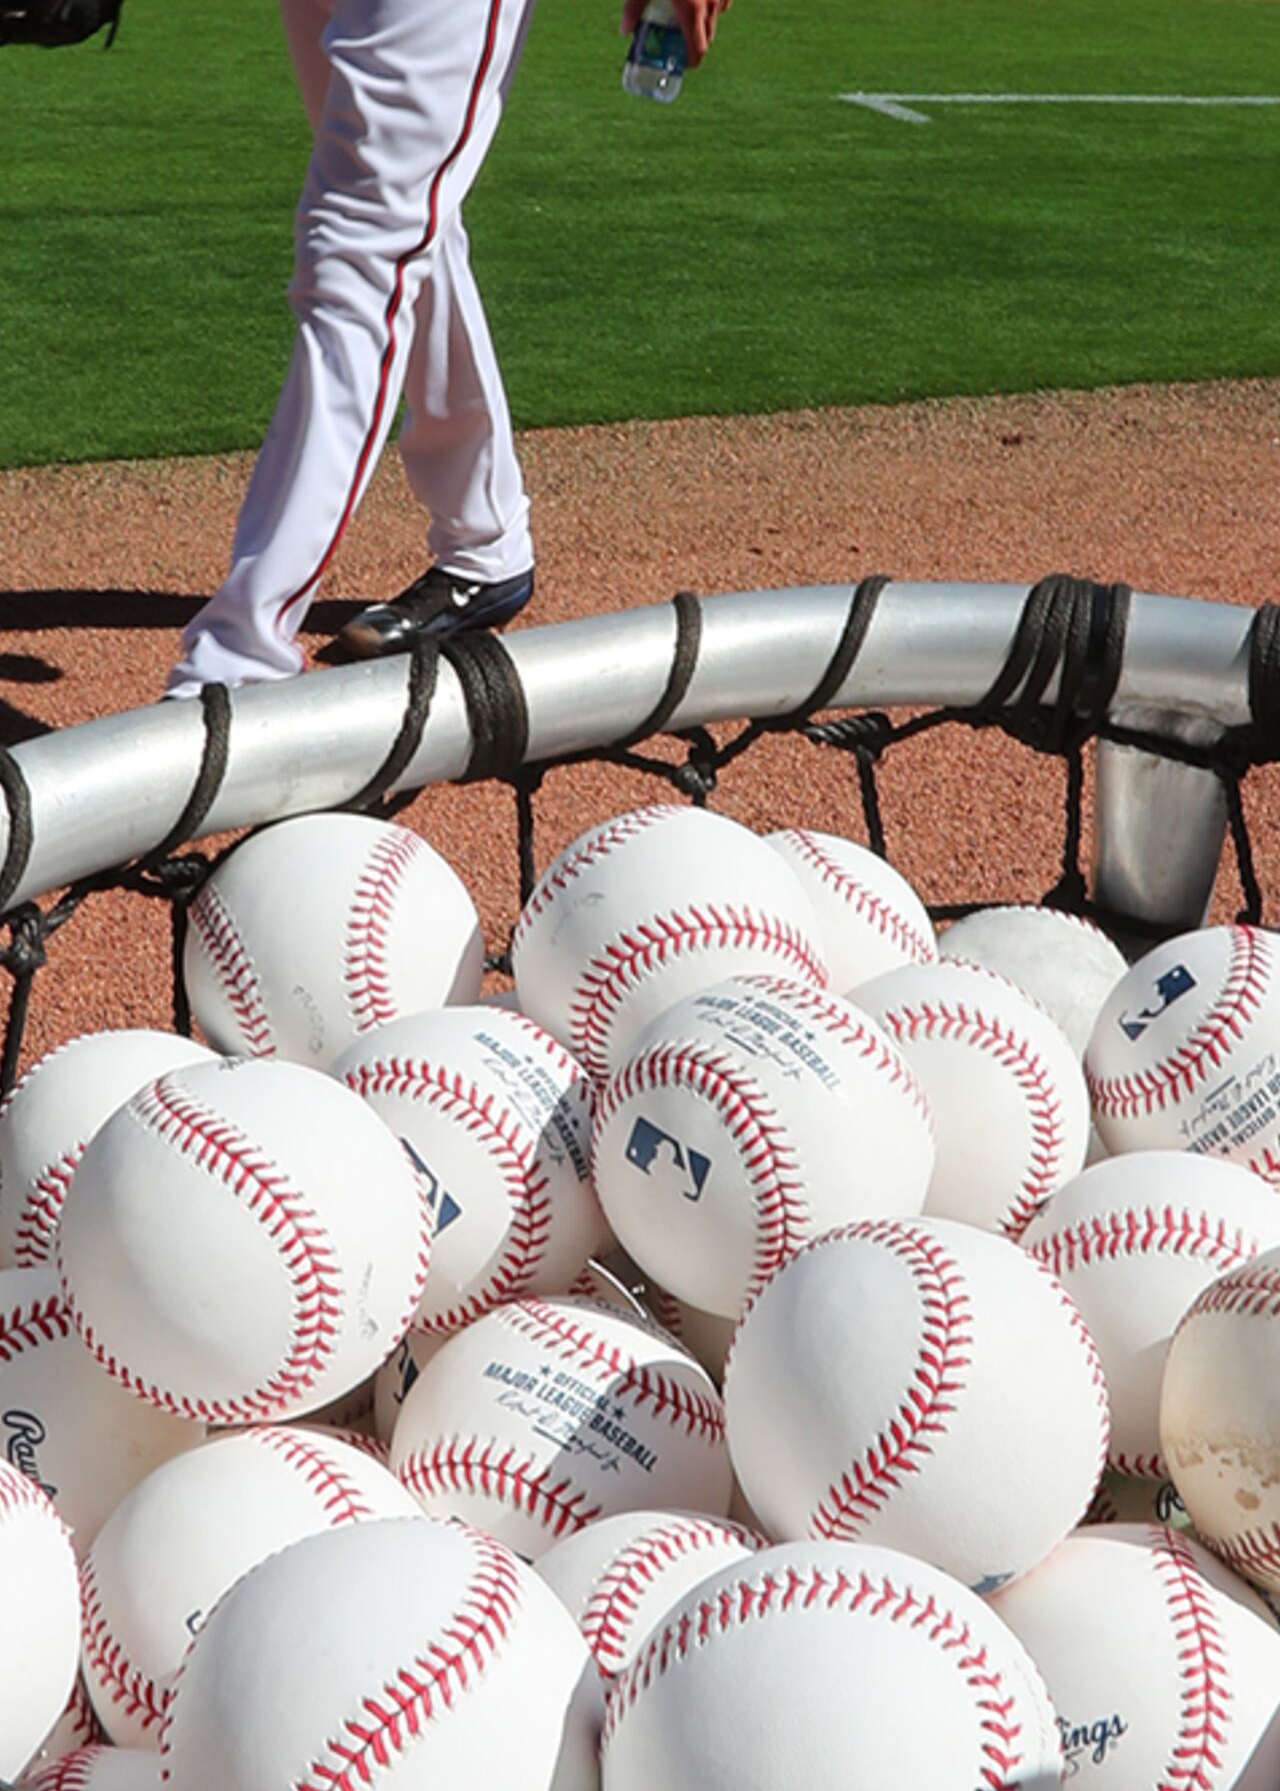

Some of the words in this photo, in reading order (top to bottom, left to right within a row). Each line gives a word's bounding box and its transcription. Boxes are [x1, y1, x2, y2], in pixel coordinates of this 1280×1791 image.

[735, 1006, 783, 1035] LEAGUE
[778, 1030, 842, 1091] BASEBALL
[1226, 1087, 1271, 1131] LEAGUE
[1230, 1106, 1277, 1147] OFFICIAL
[553, 1371, 611, 1412] OFFICIAL
[483, 1361, 539, 1393] MAJOR
[536, 1383, 592, 1425] LEAGUE
[588, 1412, 660, 1474] BASEBALL
